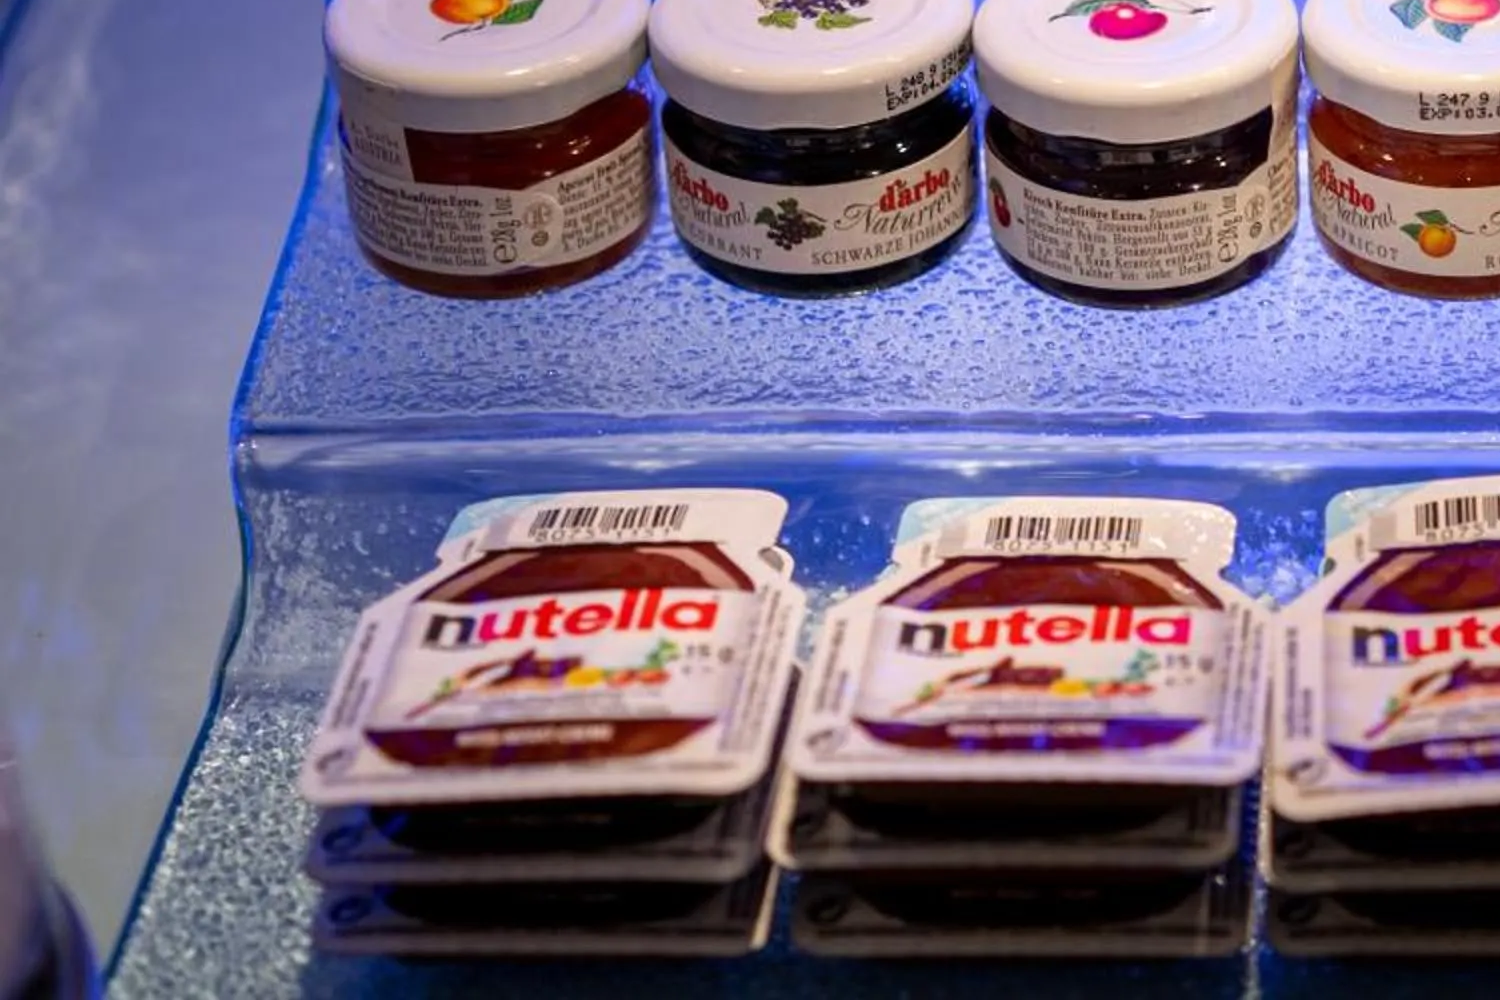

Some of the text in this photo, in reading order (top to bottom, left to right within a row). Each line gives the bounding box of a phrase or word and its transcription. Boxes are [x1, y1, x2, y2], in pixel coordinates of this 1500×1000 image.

[1418, 91, 1431, 107] L
[1437, 92, 1471, 107] 247
[1478, 91, 1490, 106] 9
[878, 167, 951, 213] d'arbo
[810, 236, 903, 265] SCHWARZE
[424, 588, 719, 645] nutella
[898, 603, 1193, 654] nutella
